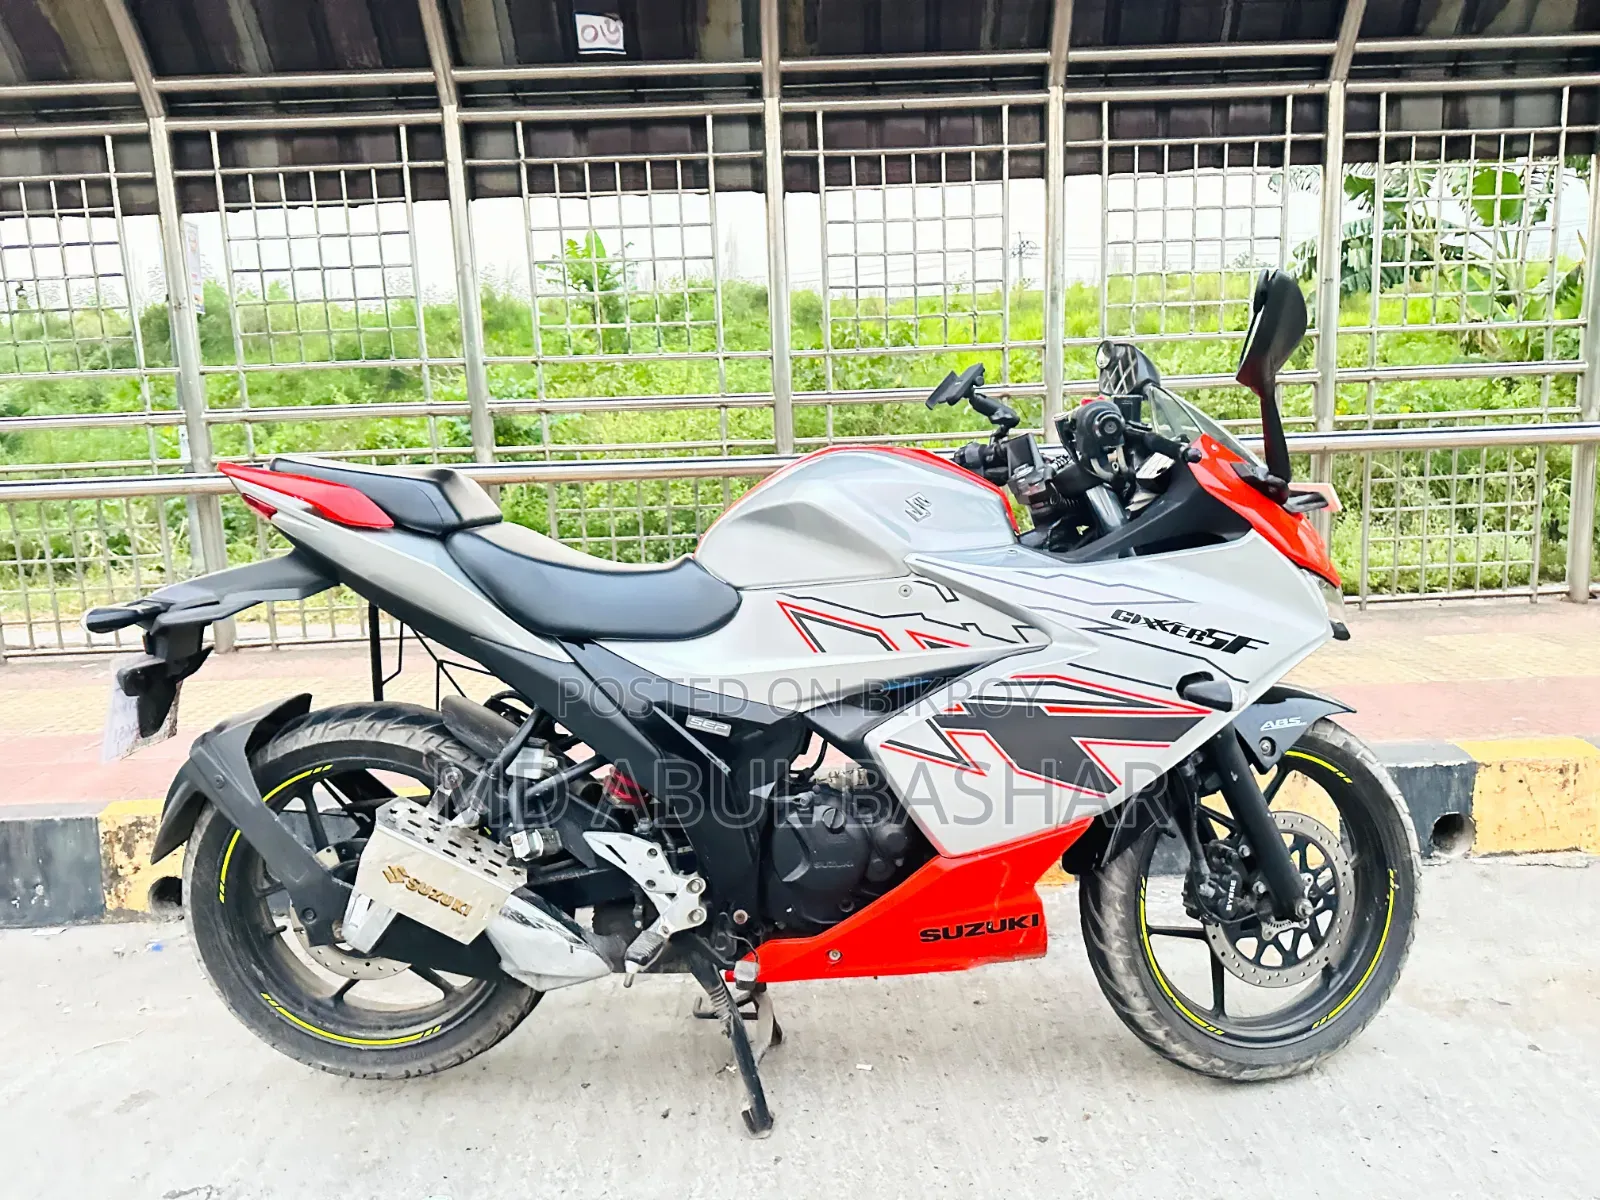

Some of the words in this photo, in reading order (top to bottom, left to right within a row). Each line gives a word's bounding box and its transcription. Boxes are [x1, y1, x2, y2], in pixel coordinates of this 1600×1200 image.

[689, 717, 729, 732] SEP
[1259, 716, 1302, 731] ABS
[405, 878, 473, 917] SUZUKI
[919, 913, 1039, 943] SUZUKI
